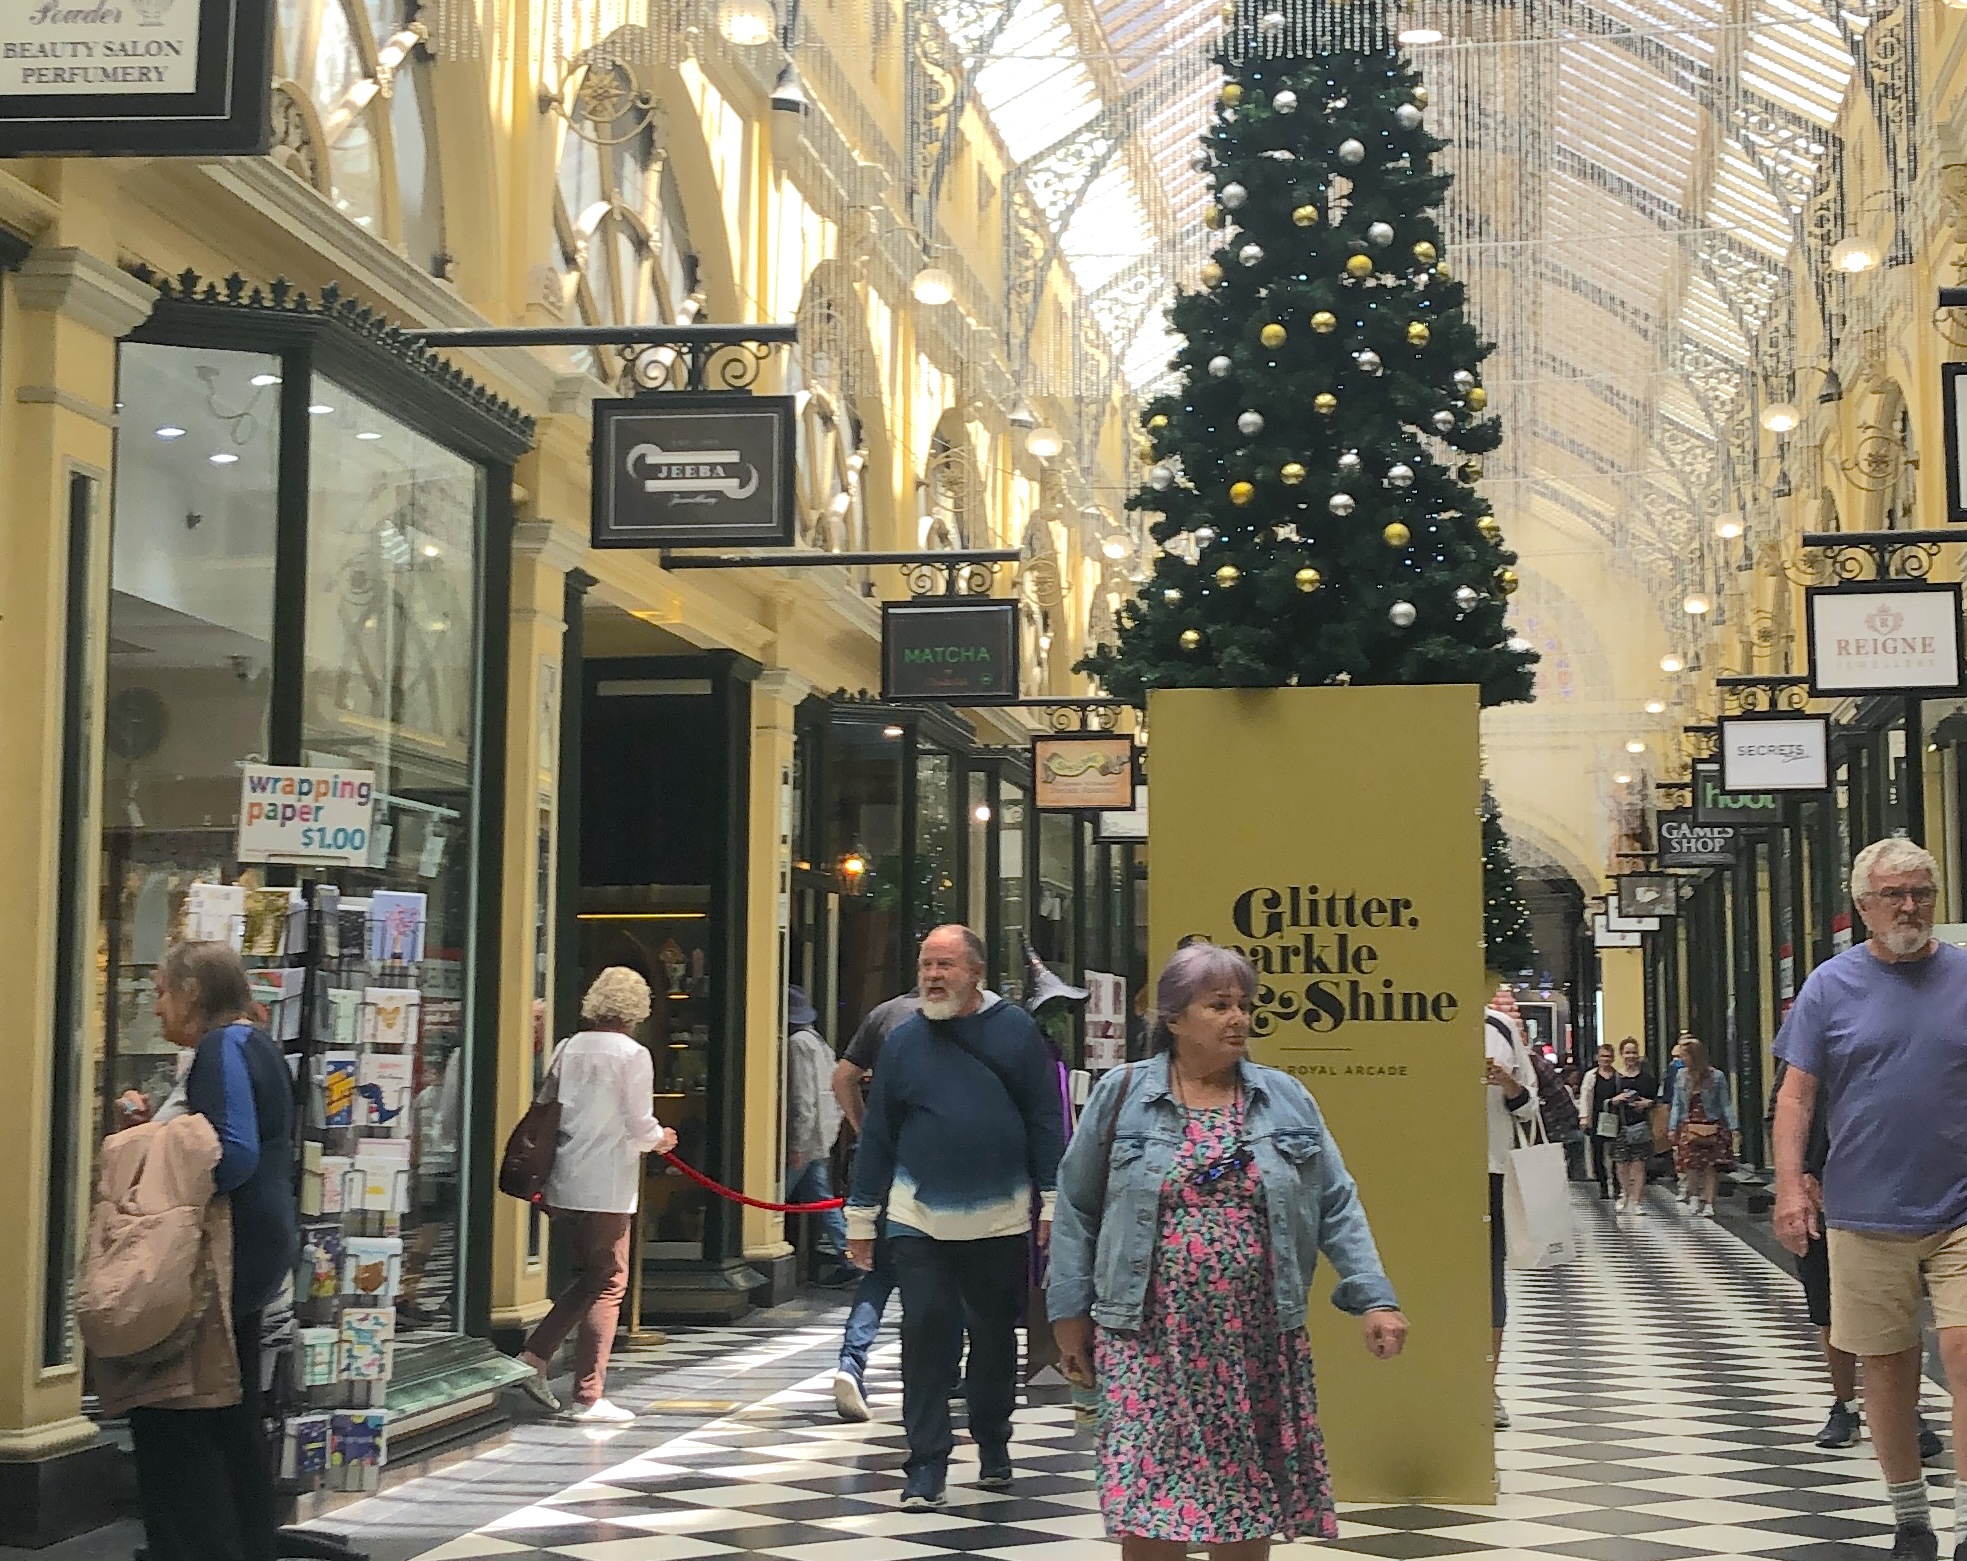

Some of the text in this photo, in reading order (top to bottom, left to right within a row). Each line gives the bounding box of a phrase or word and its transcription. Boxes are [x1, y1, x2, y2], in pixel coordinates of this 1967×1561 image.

[3, 40, 183, 59] BEAUTY SALON
[21, 66, 169, 84] PERFUMERY
[658, 465, 726, 478] JEEBA
[904, 647, 991, 663] MATCHA
[1836, 636, 1936, 656] REIGNE
[1737, 744, 1805, 756] SECRETS
[248, 774, 371, 806] wrapping
[247, 801, 324, 827] paper
[301, 827, 366, 850] $1.00
[1670, 838, 1726, 853] SHOP
[1232, 884, 1420, 940] Glitter.
[1287, 1065, 1338, 1076] ROYAL
[1344, 1065, 1408, 1076] ARCADE
